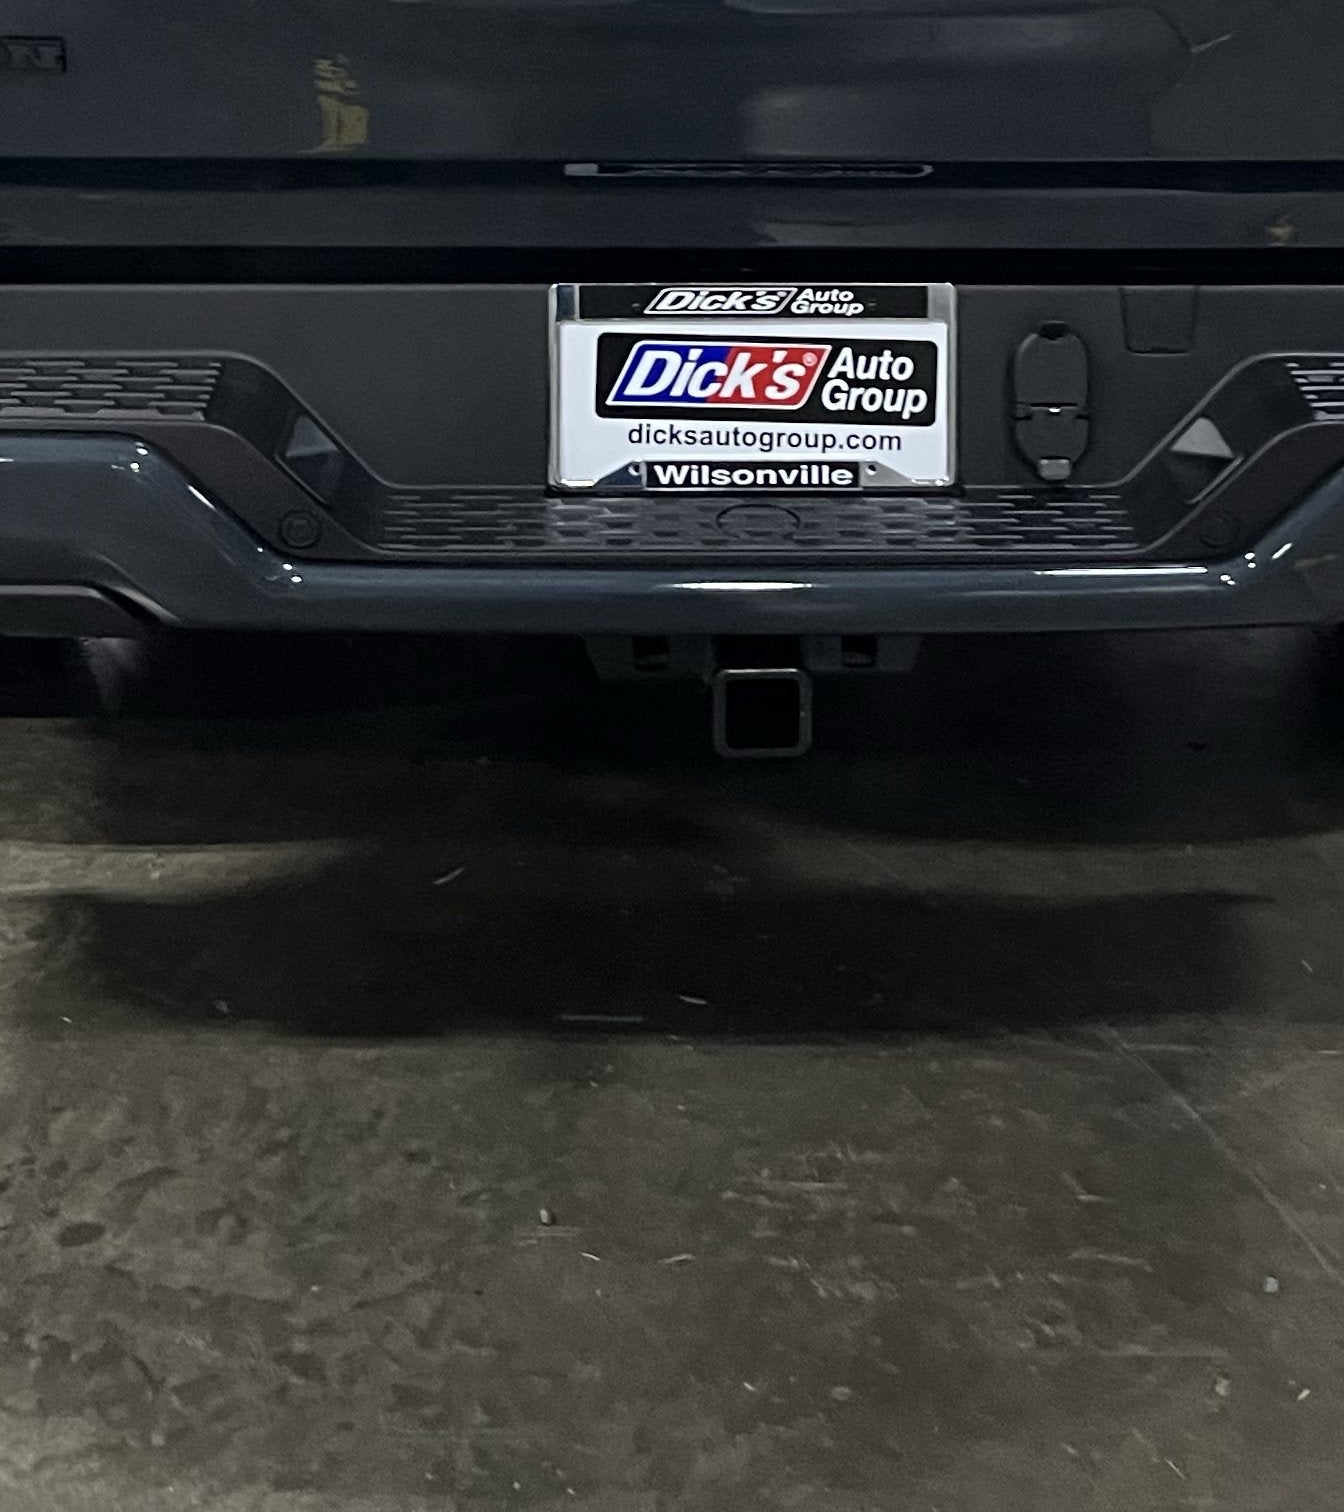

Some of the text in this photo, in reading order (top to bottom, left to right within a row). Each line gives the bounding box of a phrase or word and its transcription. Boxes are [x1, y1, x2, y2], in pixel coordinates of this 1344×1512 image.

[656, 288, 855, 312] Dick's Auto
[790, 300, 864, 316] Group
[622, 345, 915, 401] Dick's Auto
[820, 380, 929, 419] Group
[627, 423, 904, 453] dicksautogroup.com
[653, 464, 855, 487] Wilsonville
